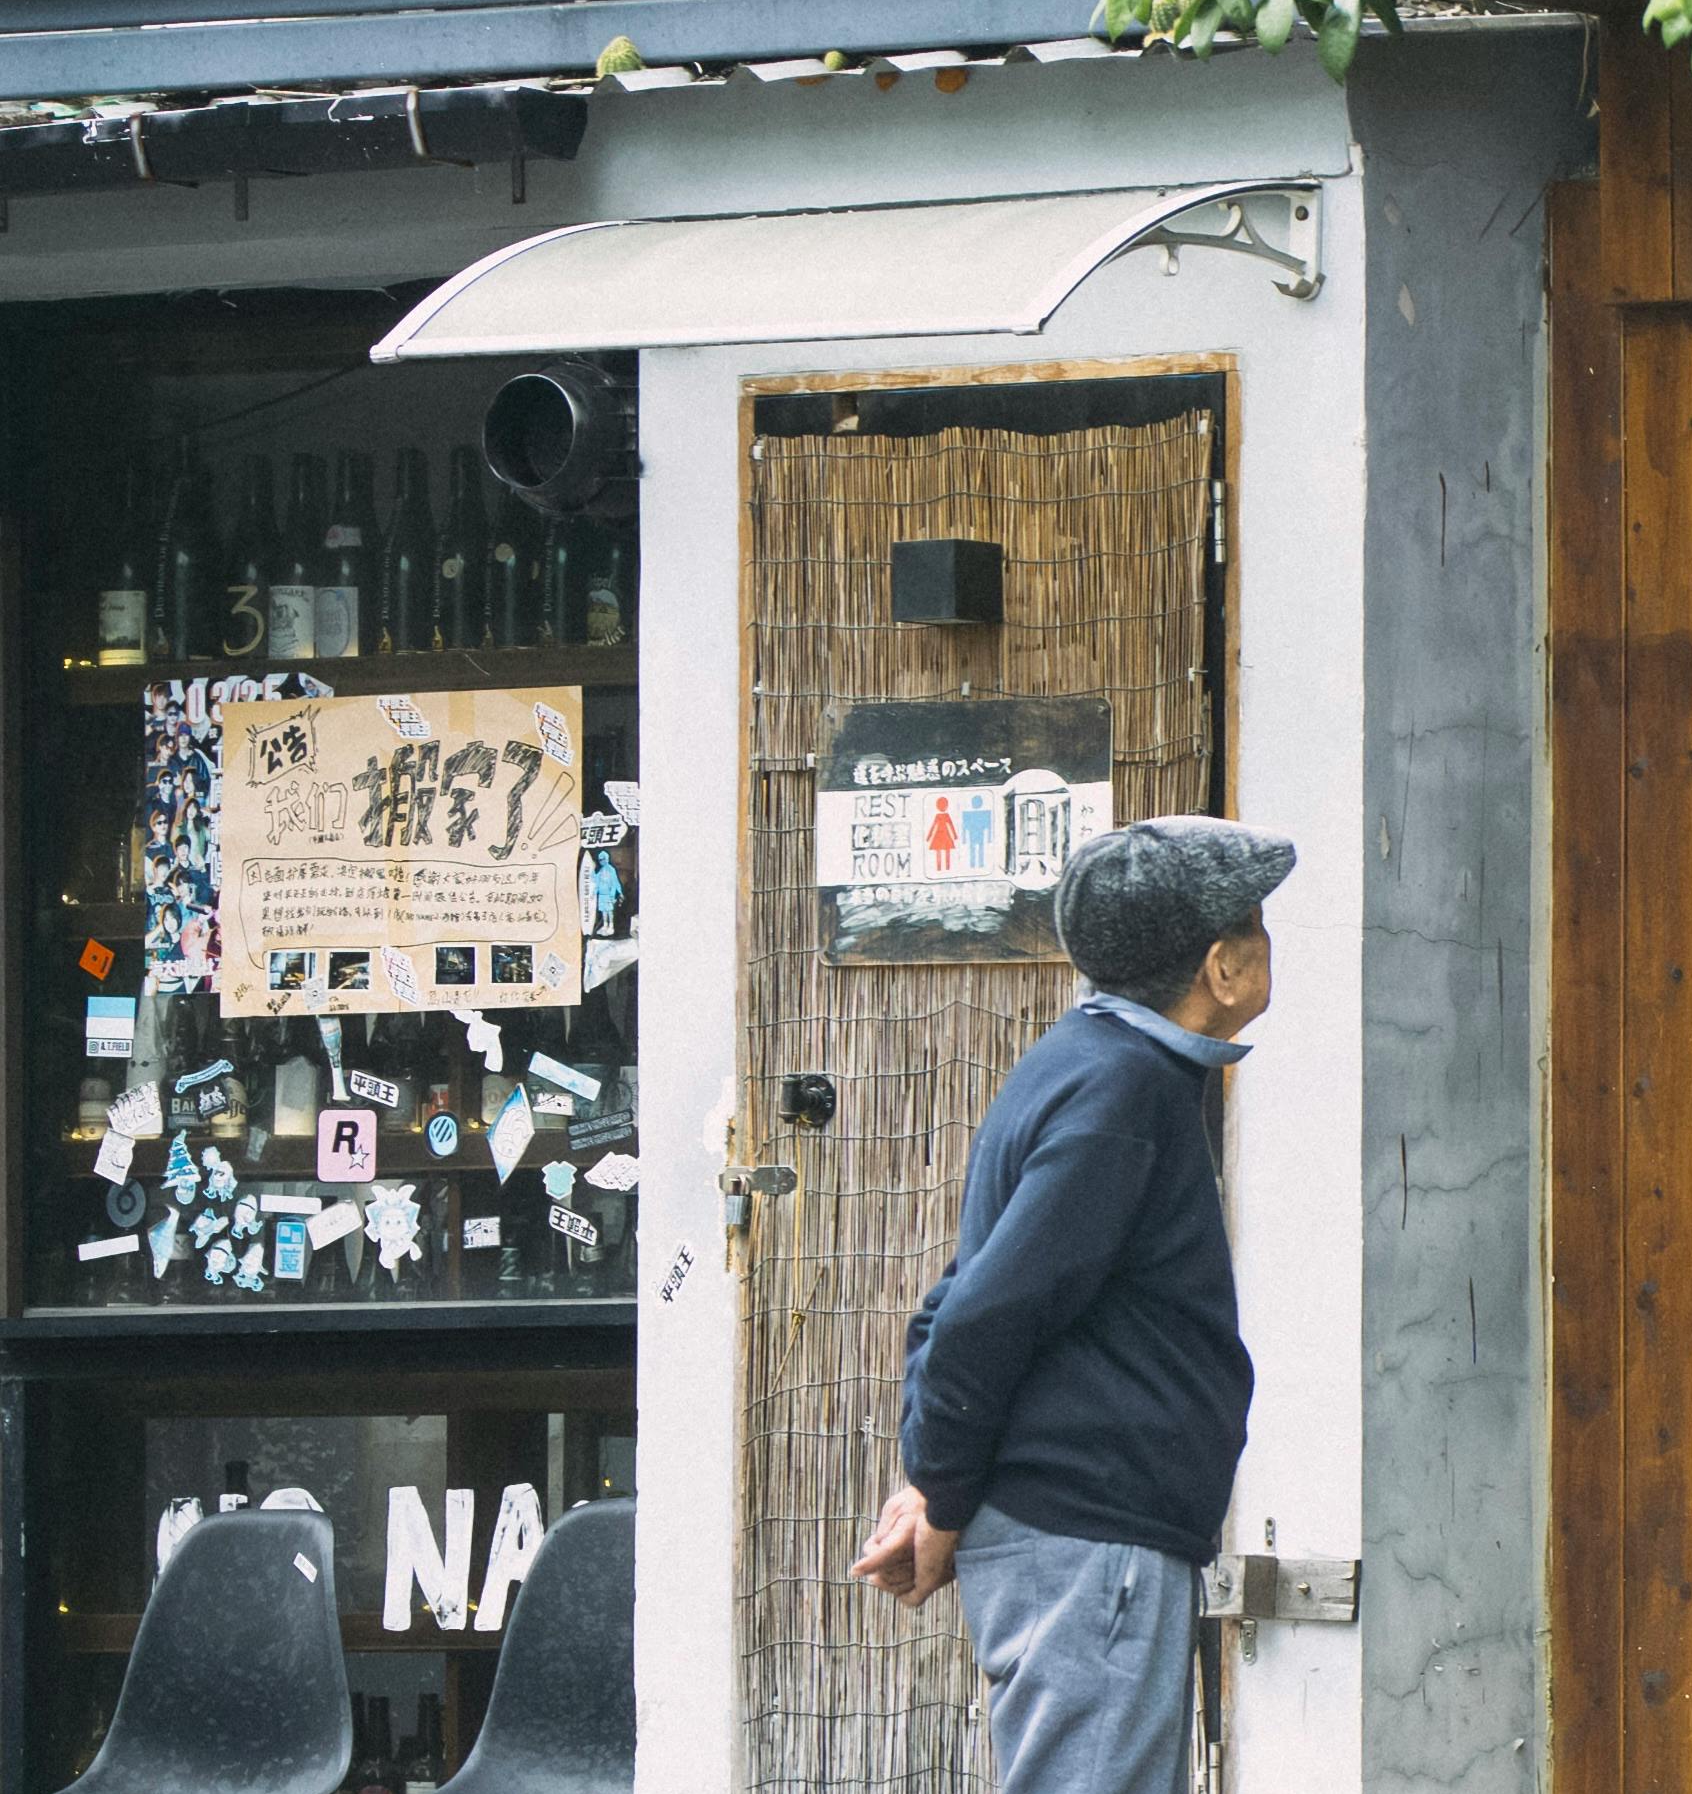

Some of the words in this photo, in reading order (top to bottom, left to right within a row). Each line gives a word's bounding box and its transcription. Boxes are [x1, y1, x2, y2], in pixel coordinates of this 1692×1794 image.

[259, 724, 307, 775] 公告
[854, 793, 912, 819] REST
[851, 852, 912, 880] ROOM
[332, 1120, 360, 1155] R
